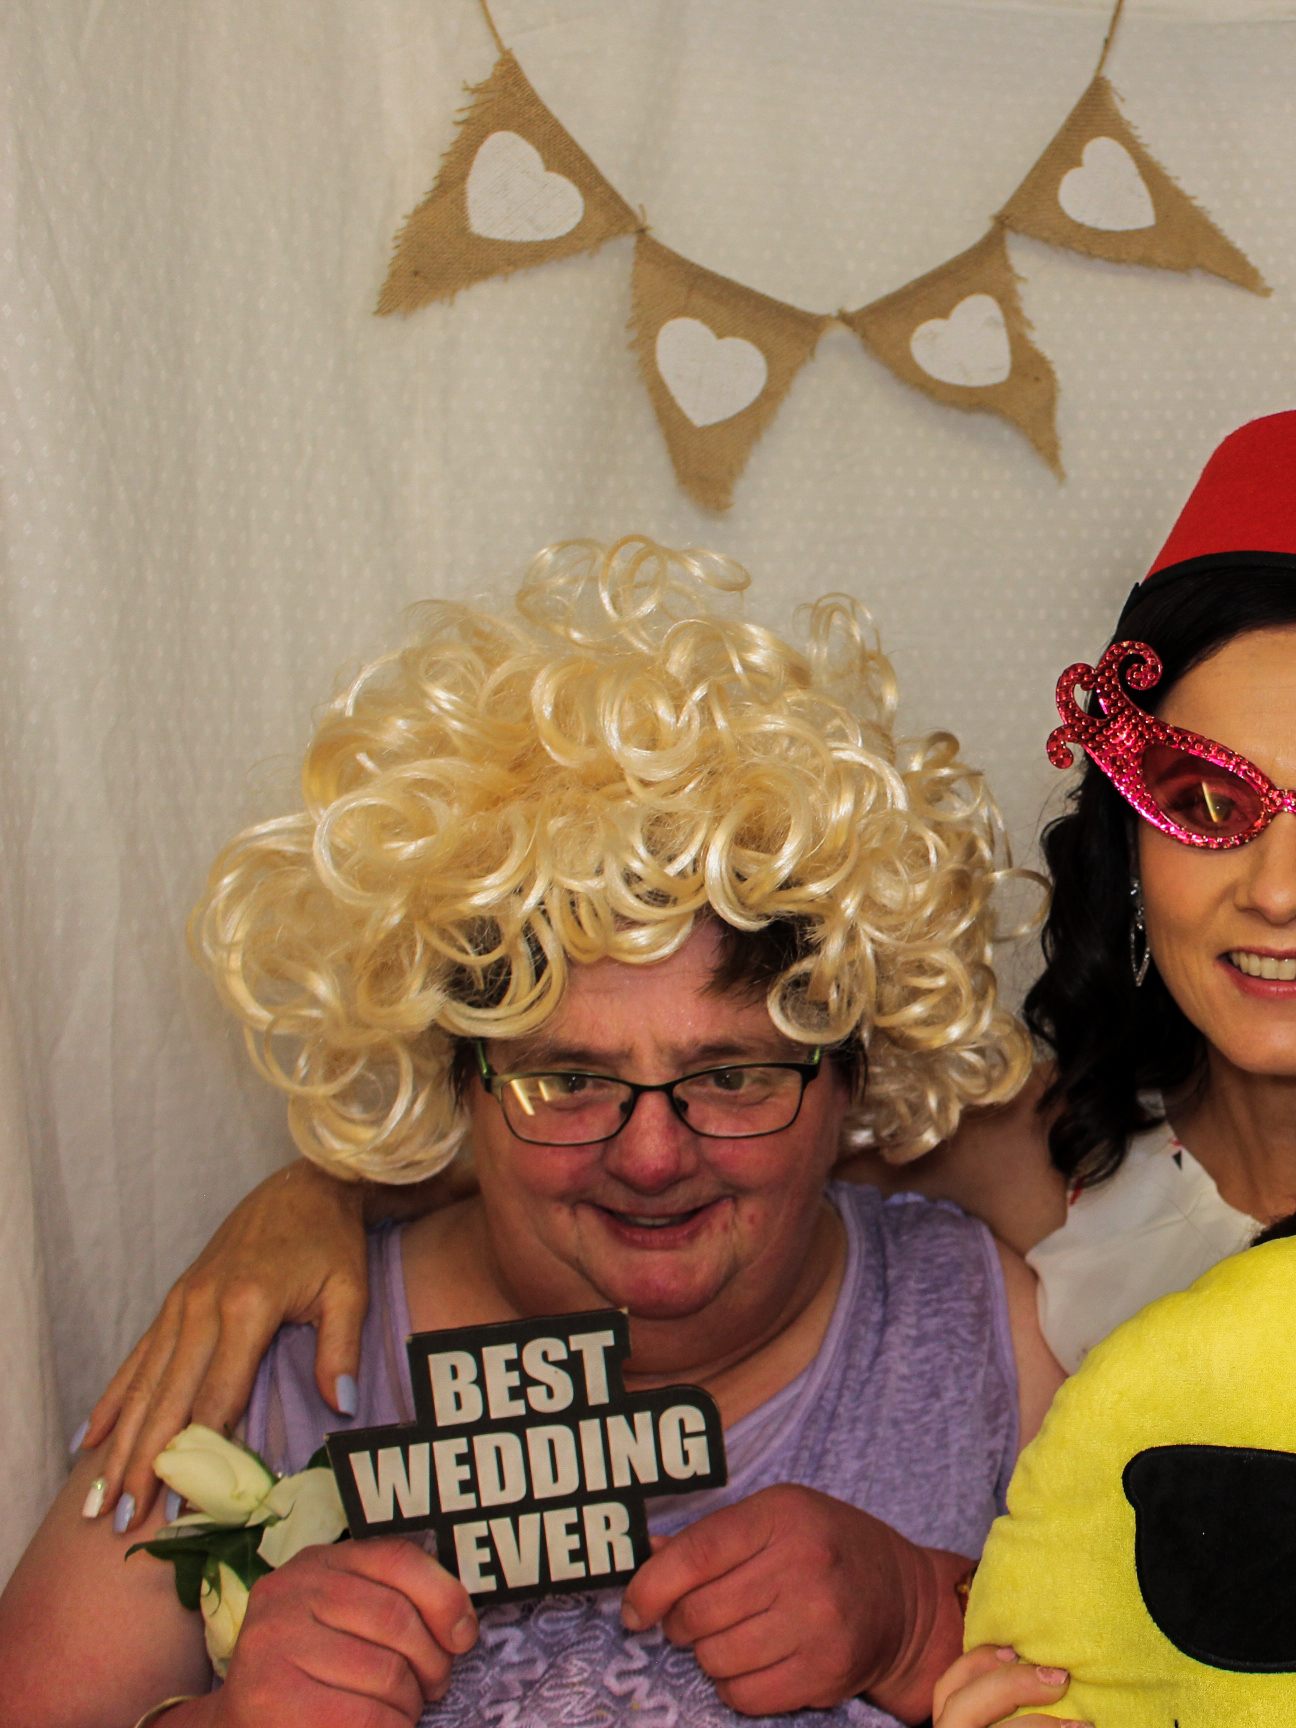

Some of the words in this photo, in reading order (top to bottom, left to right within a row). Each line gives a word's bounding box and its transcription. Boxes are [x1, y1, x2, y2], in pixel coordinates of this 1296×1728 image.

[428, 1330, 615, 1427] BEST
[348, 1404, 711, 1524] WEDDING
[453, 1501, 635, 1595] EVER
